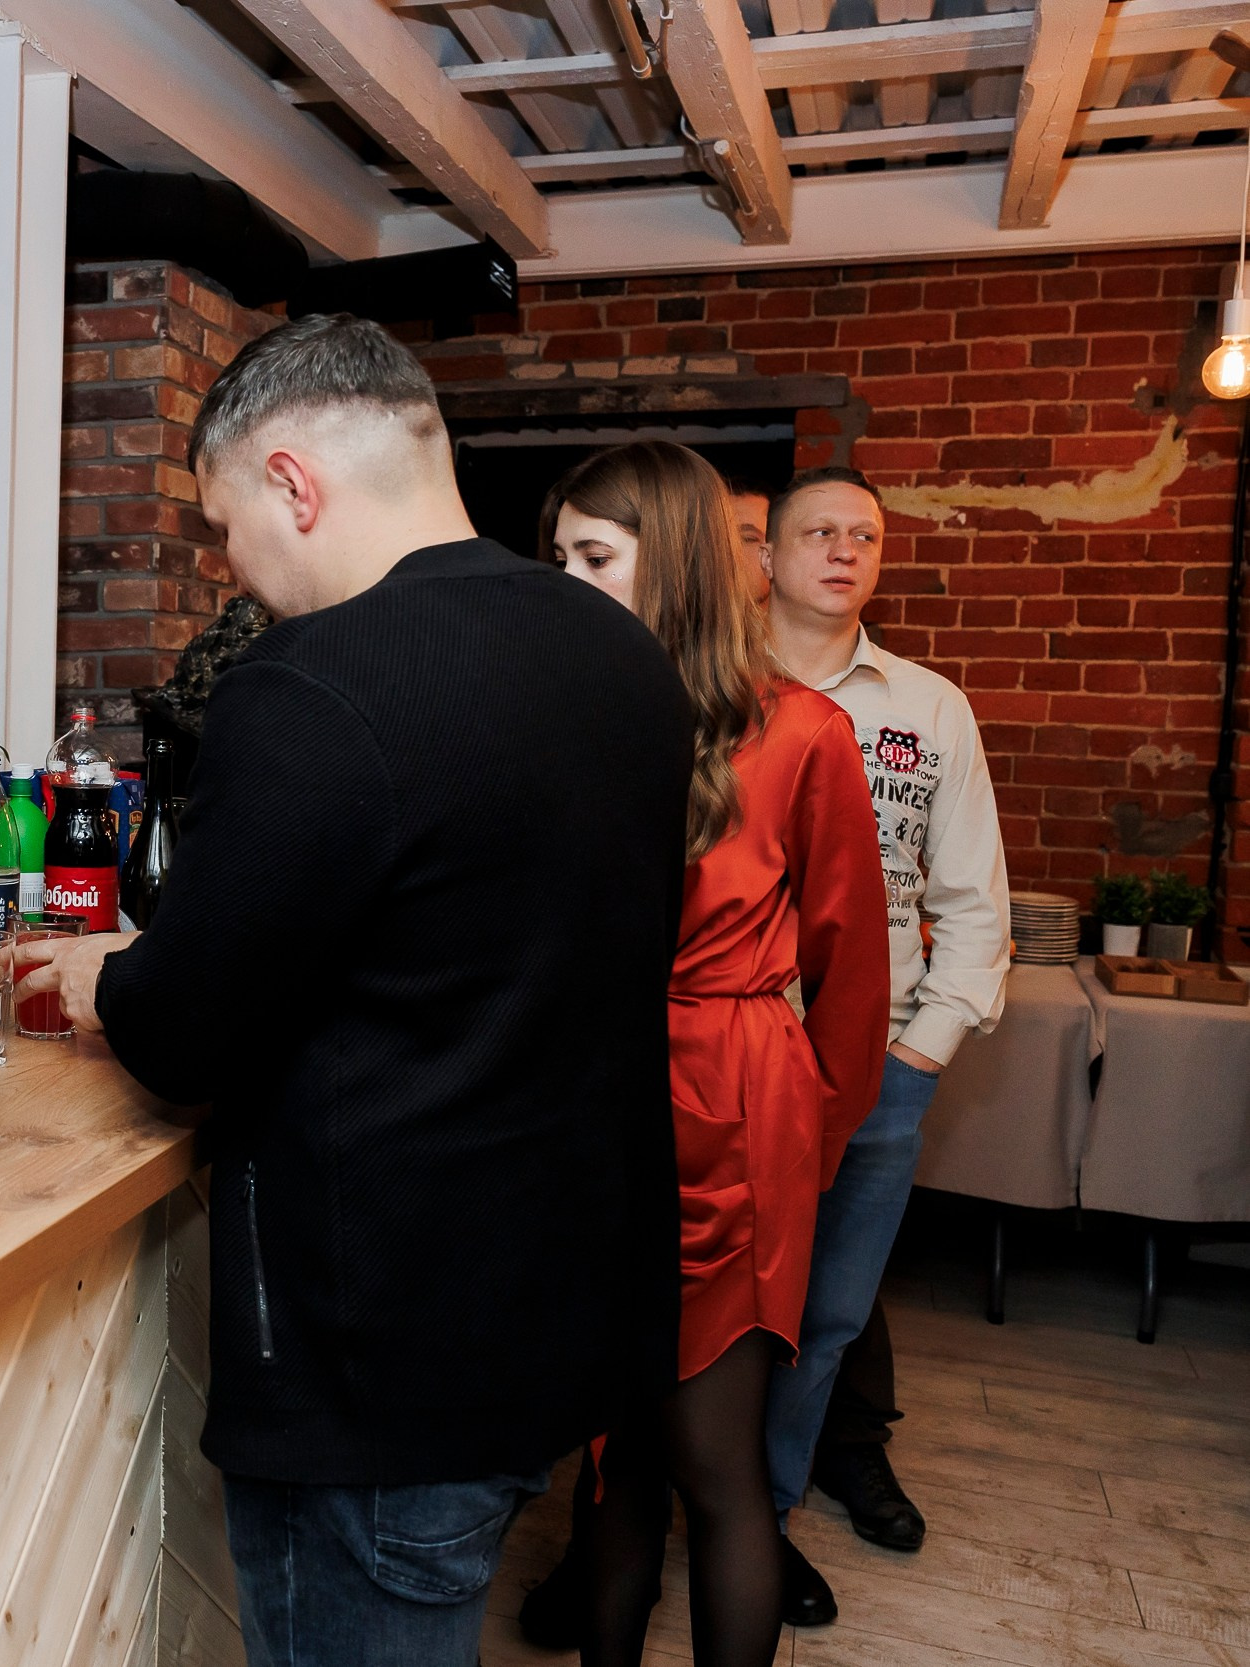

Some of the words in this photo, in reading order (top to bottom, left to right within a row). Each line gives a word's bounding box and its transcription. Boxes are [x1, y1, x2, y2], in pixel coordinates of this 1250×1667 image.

[885, 746, 912, 763] EDT
[864, 760, 881, 770] HE
[895, 817, 909, 841] &
[42, 884, 100, 910] обрый
